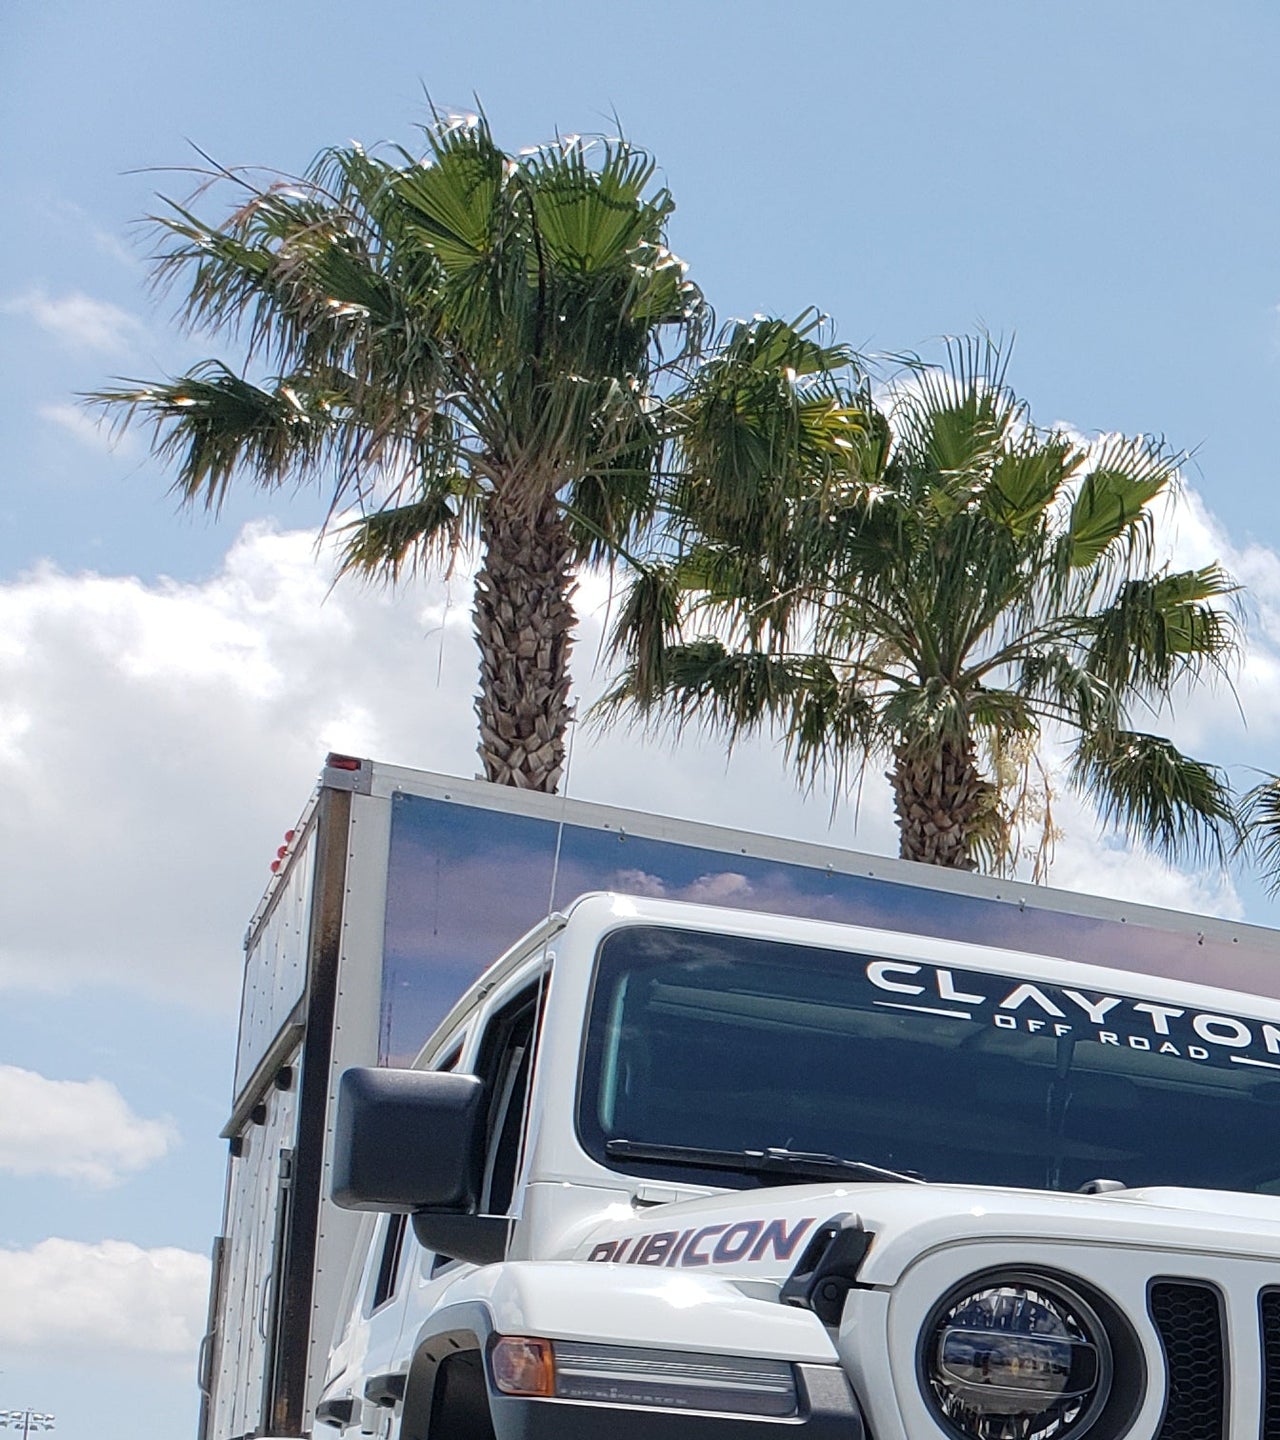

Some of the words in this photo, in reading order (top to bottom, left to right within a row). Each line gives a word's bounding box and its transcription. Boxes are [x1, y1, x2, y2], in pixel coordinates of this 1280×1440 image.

[994, 1014, 1073, 1037] OFF
[1099, 1031, 1210, 1060] ROAD
[587, 1218, 817, 1268] RUBICON
